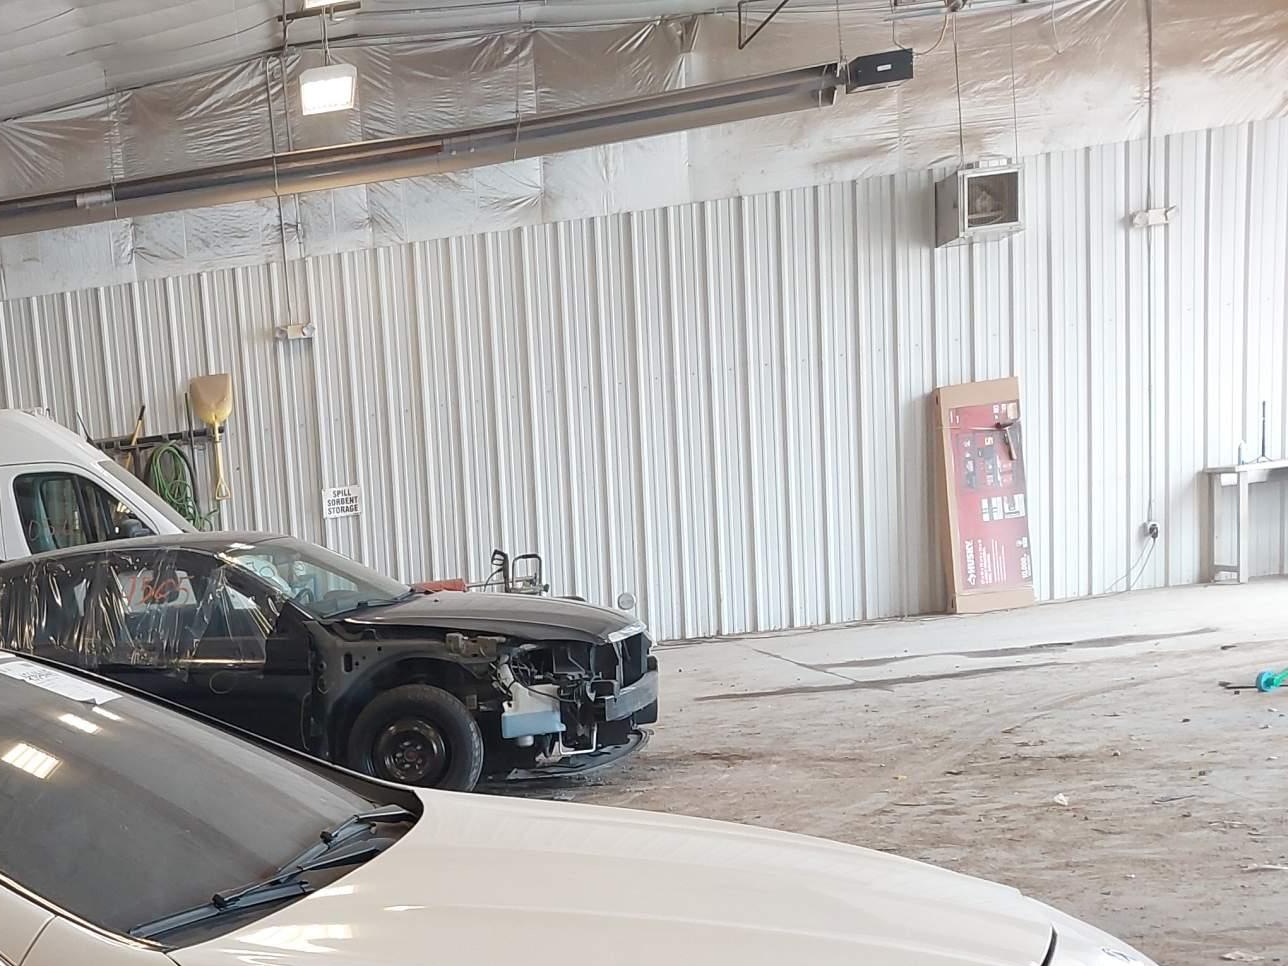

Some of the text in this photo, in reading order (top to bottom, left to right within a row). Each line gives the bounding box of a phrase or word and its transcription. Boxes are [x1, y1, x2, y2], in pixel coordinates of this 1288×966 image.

[332, 488, 352, 498] SPILL
[327, 496, 359, 507] SORBENT
[327, 504, 359, 515] STORAGE
